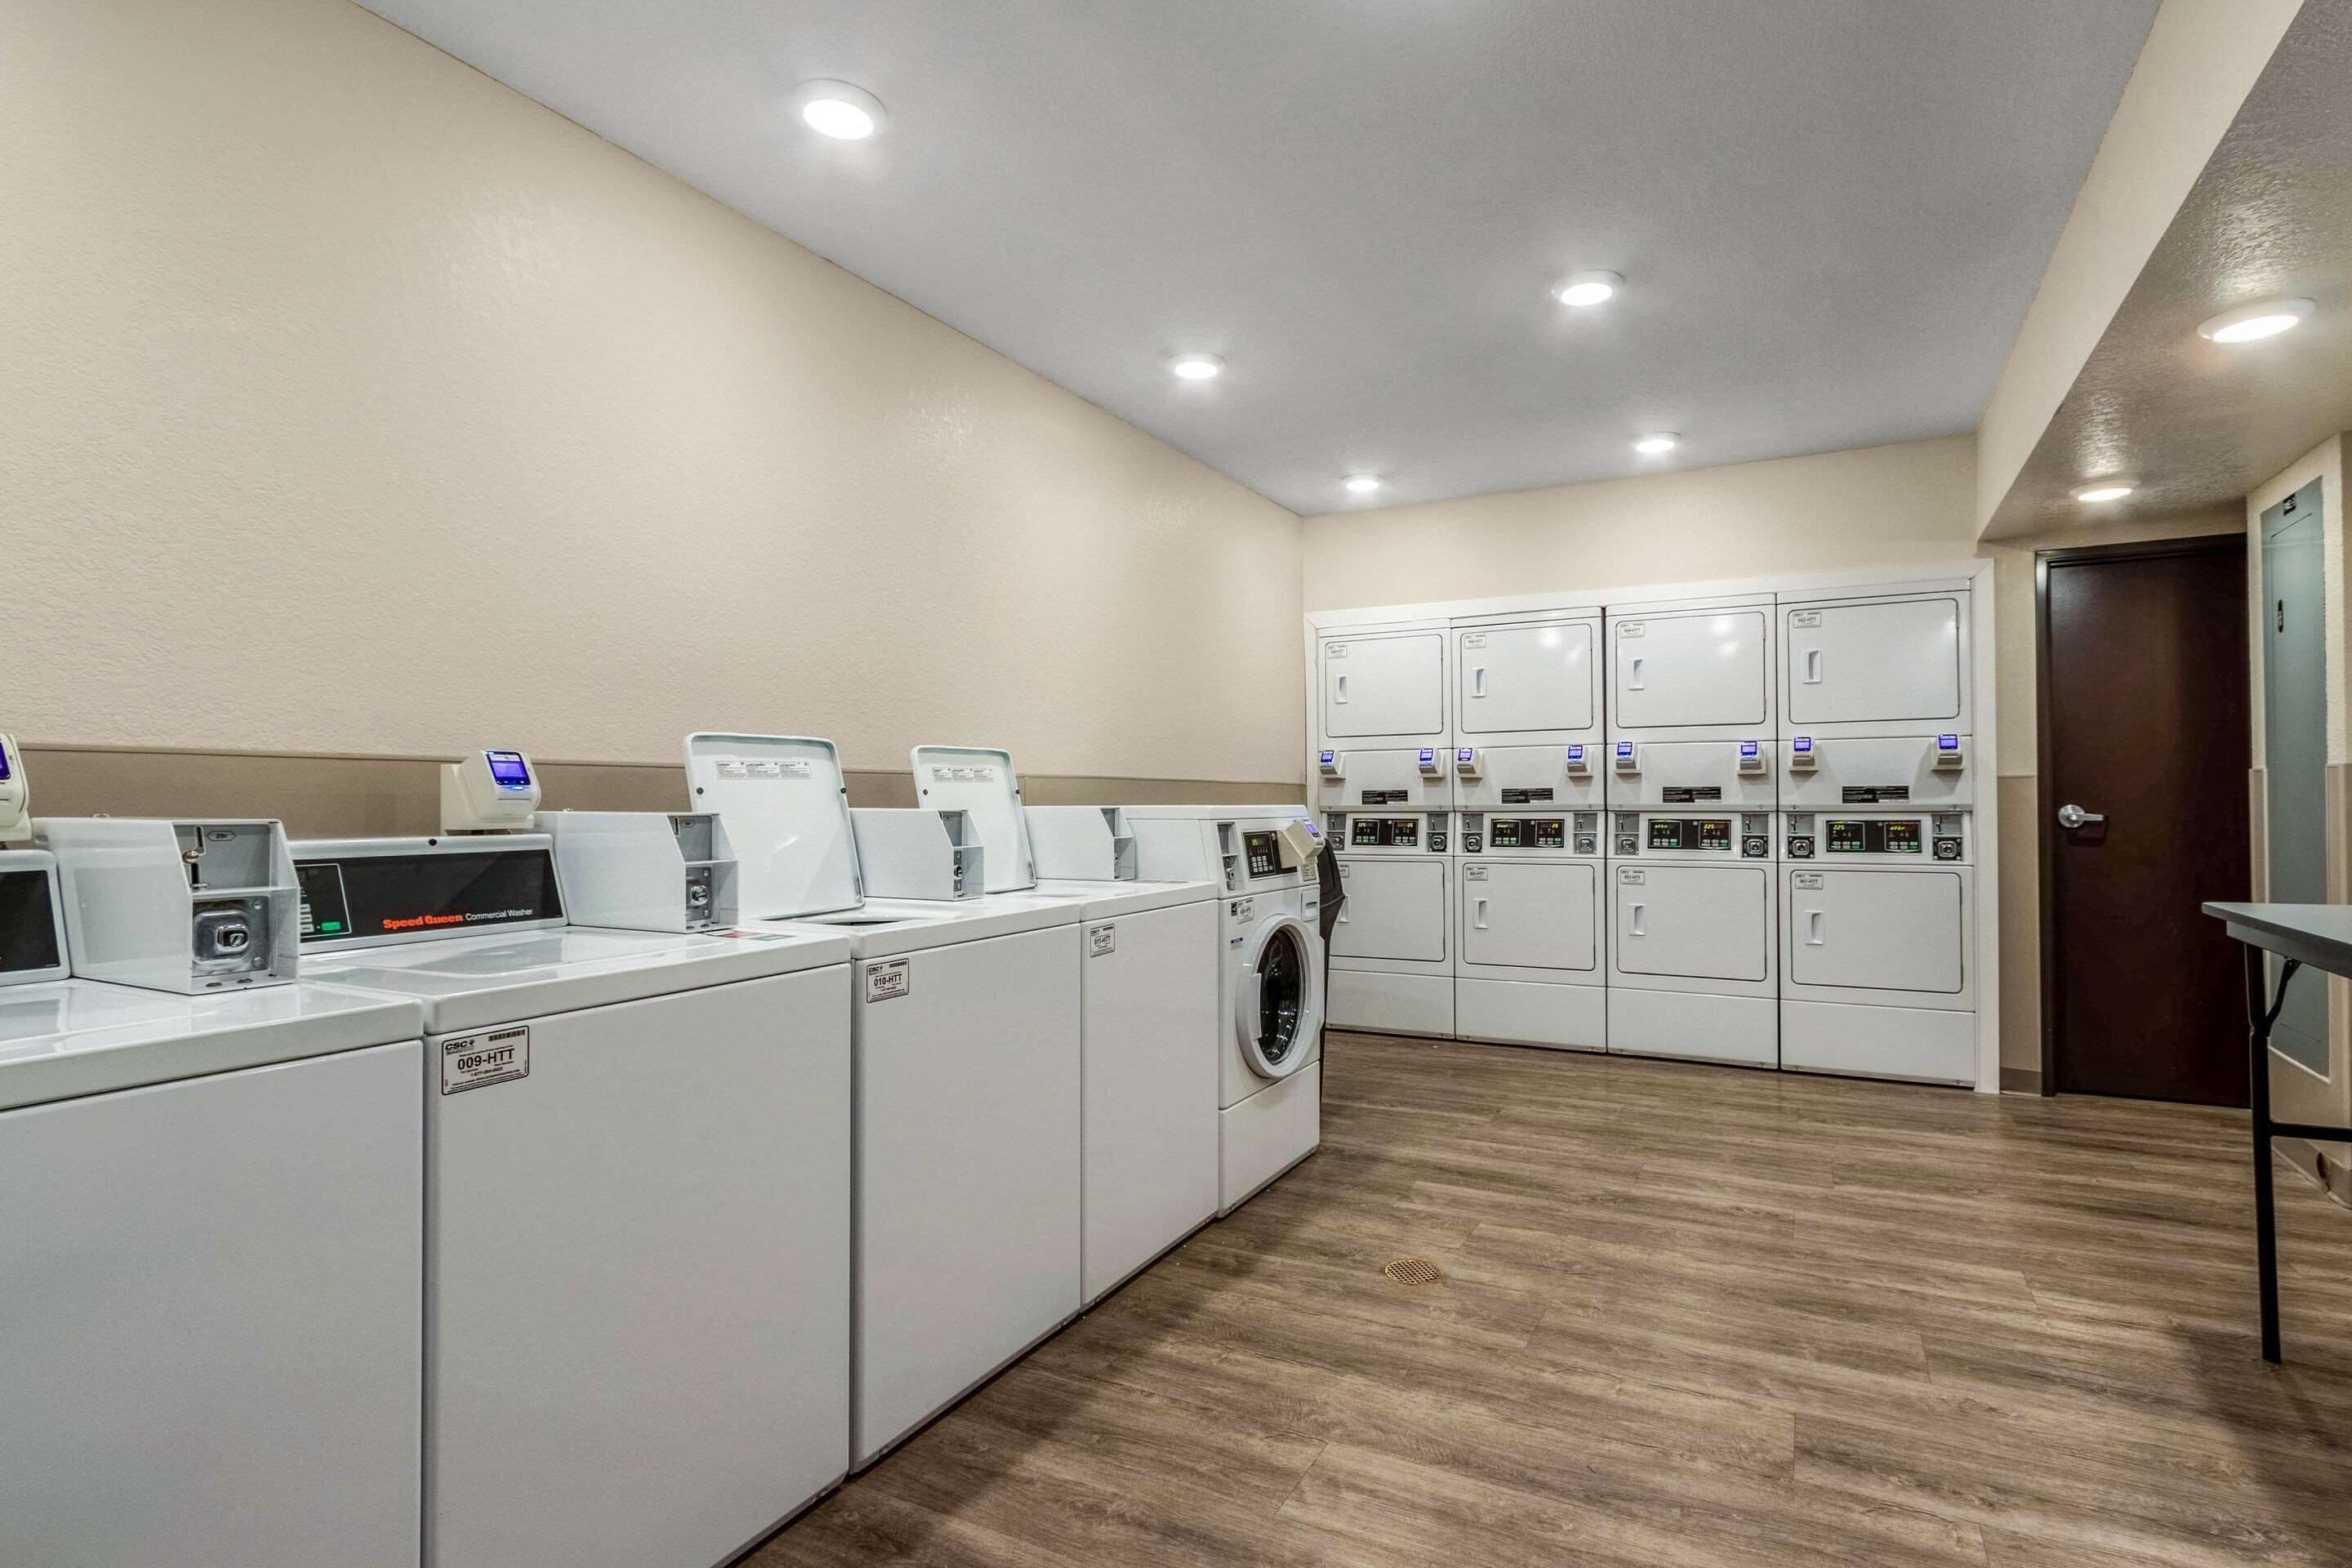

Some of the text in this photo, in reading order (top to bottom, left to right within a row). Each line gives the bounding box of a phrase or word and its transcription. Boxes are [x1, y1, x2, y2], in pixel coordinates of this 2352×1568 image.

[383, 908, 533, 930] Speed Queen Commercial Washer
[874, 973, 902, 987] 010-HTT
[445, 1040, 468, 1052] CSC
[457, 1048, 515, 1071] 009-HTT
